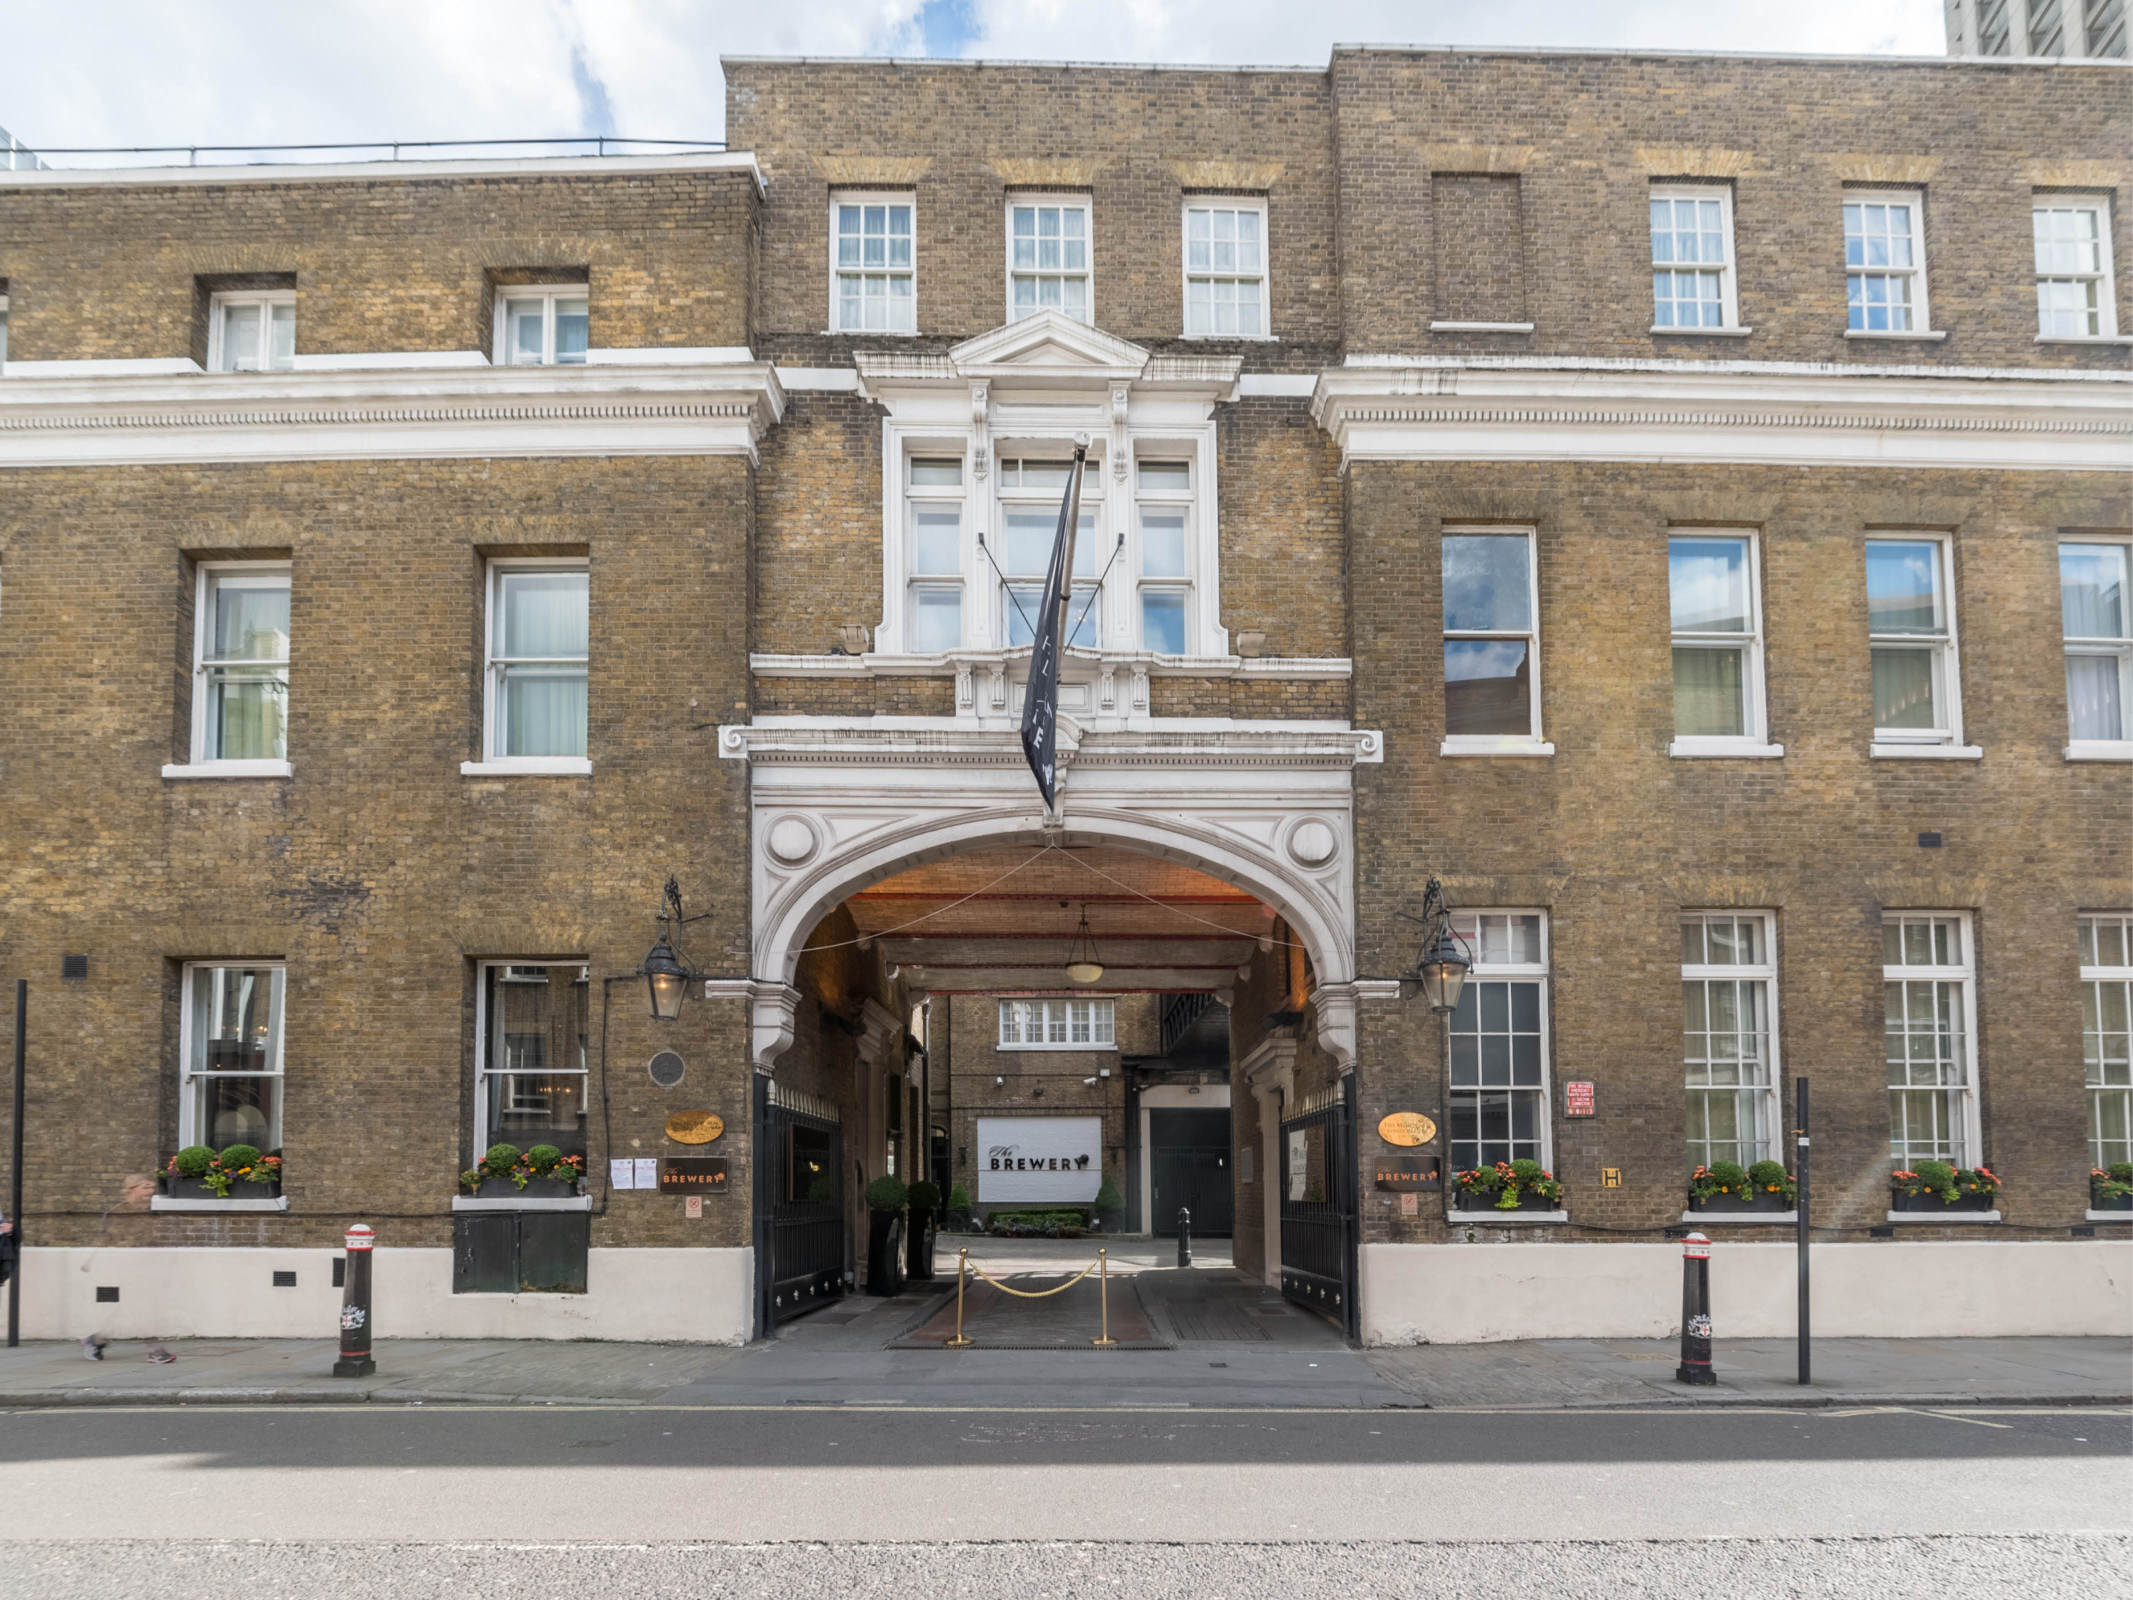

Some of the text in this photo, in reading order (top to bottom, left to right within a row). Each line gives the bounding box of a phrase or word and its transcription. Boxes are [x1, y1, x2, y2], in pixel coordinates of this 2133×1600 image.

[989, 1144, 1020, 1157] The
[990, 1158, 1084, 1170] BREWERY
[663, 1175, 721, 1183] BREWERY
[1377, 1172, 1434, 1181] BREWERY
[1604, 1170, 1619, 1186] H
